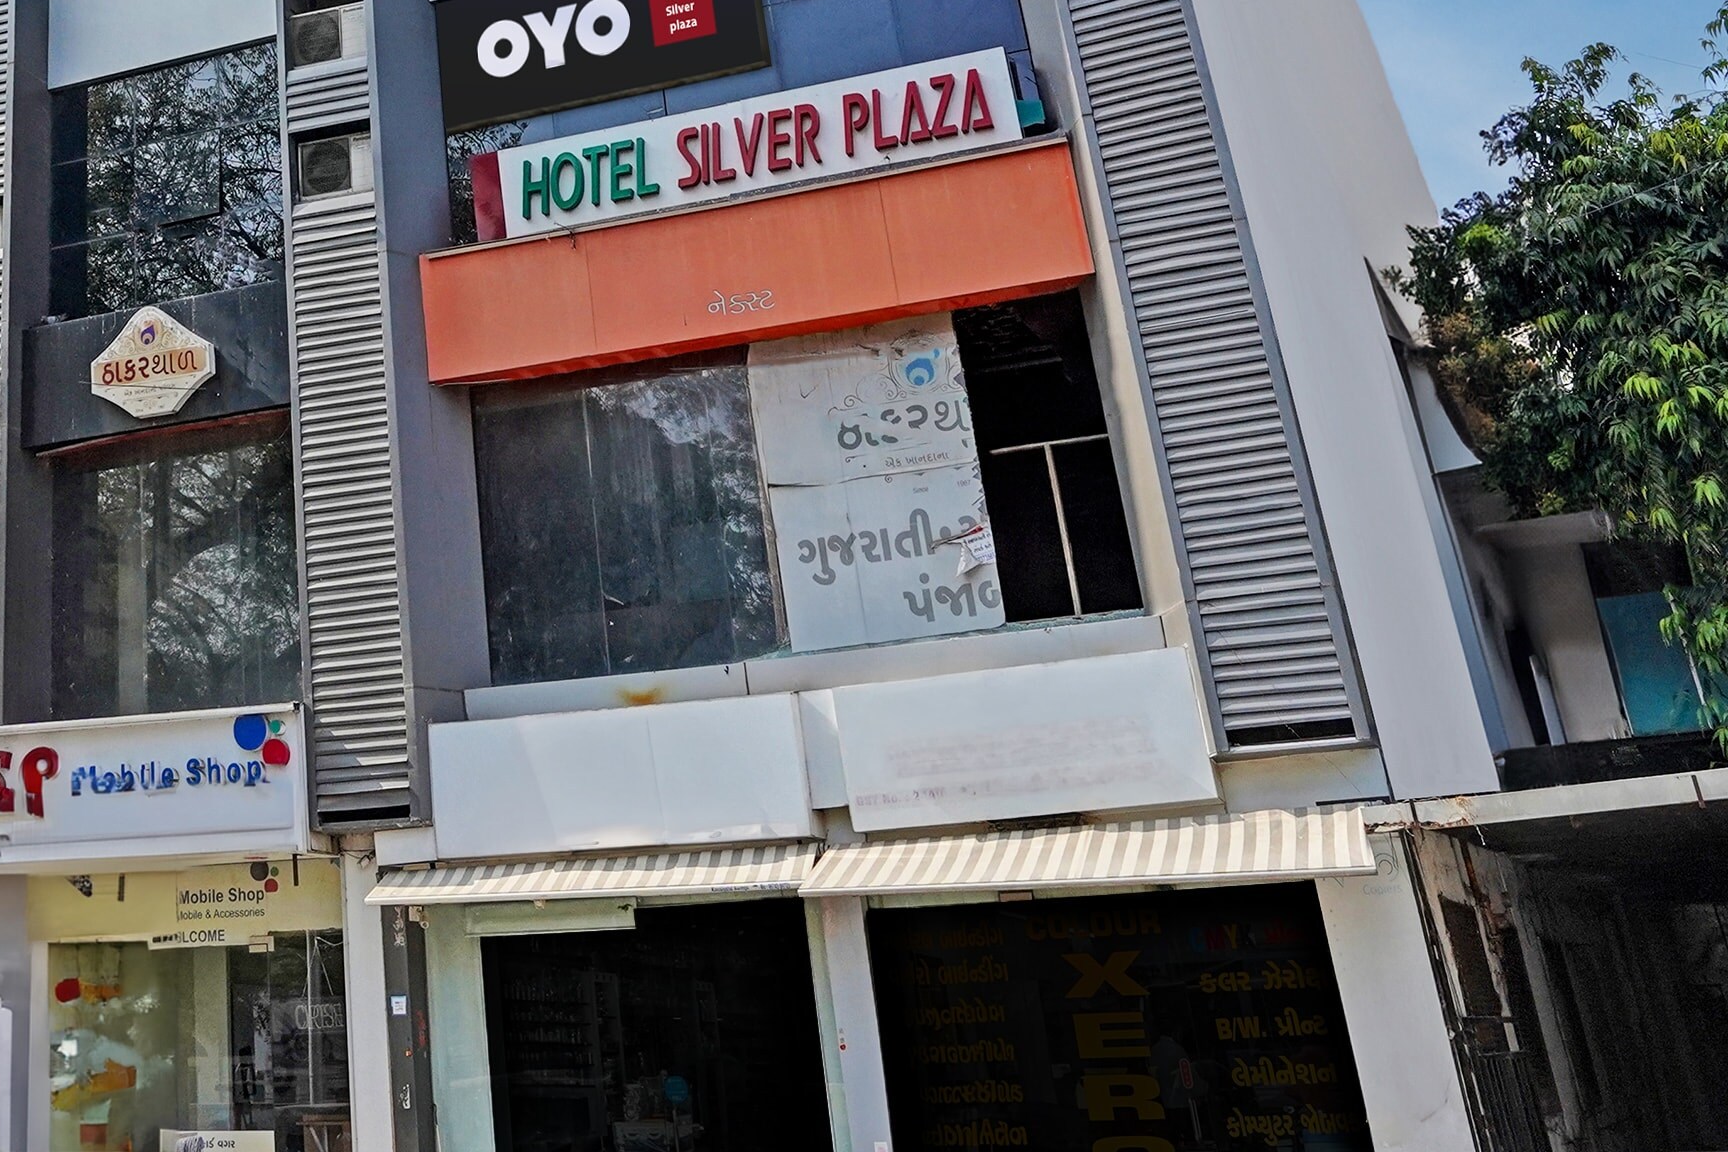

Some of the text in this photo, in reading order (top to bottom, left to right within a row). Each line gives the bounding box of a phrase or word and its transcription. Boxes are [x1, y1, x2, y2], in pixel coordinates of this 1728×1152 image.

[669, 17, 698, 35] plaza
[521, 68, 996, 220] HOTEL SILVER PLAZA
[186, 757, 269, 788] Shop
[179, 887, 265, 906] Mobile Shop
[213, 907, 265, 919] Accessories
